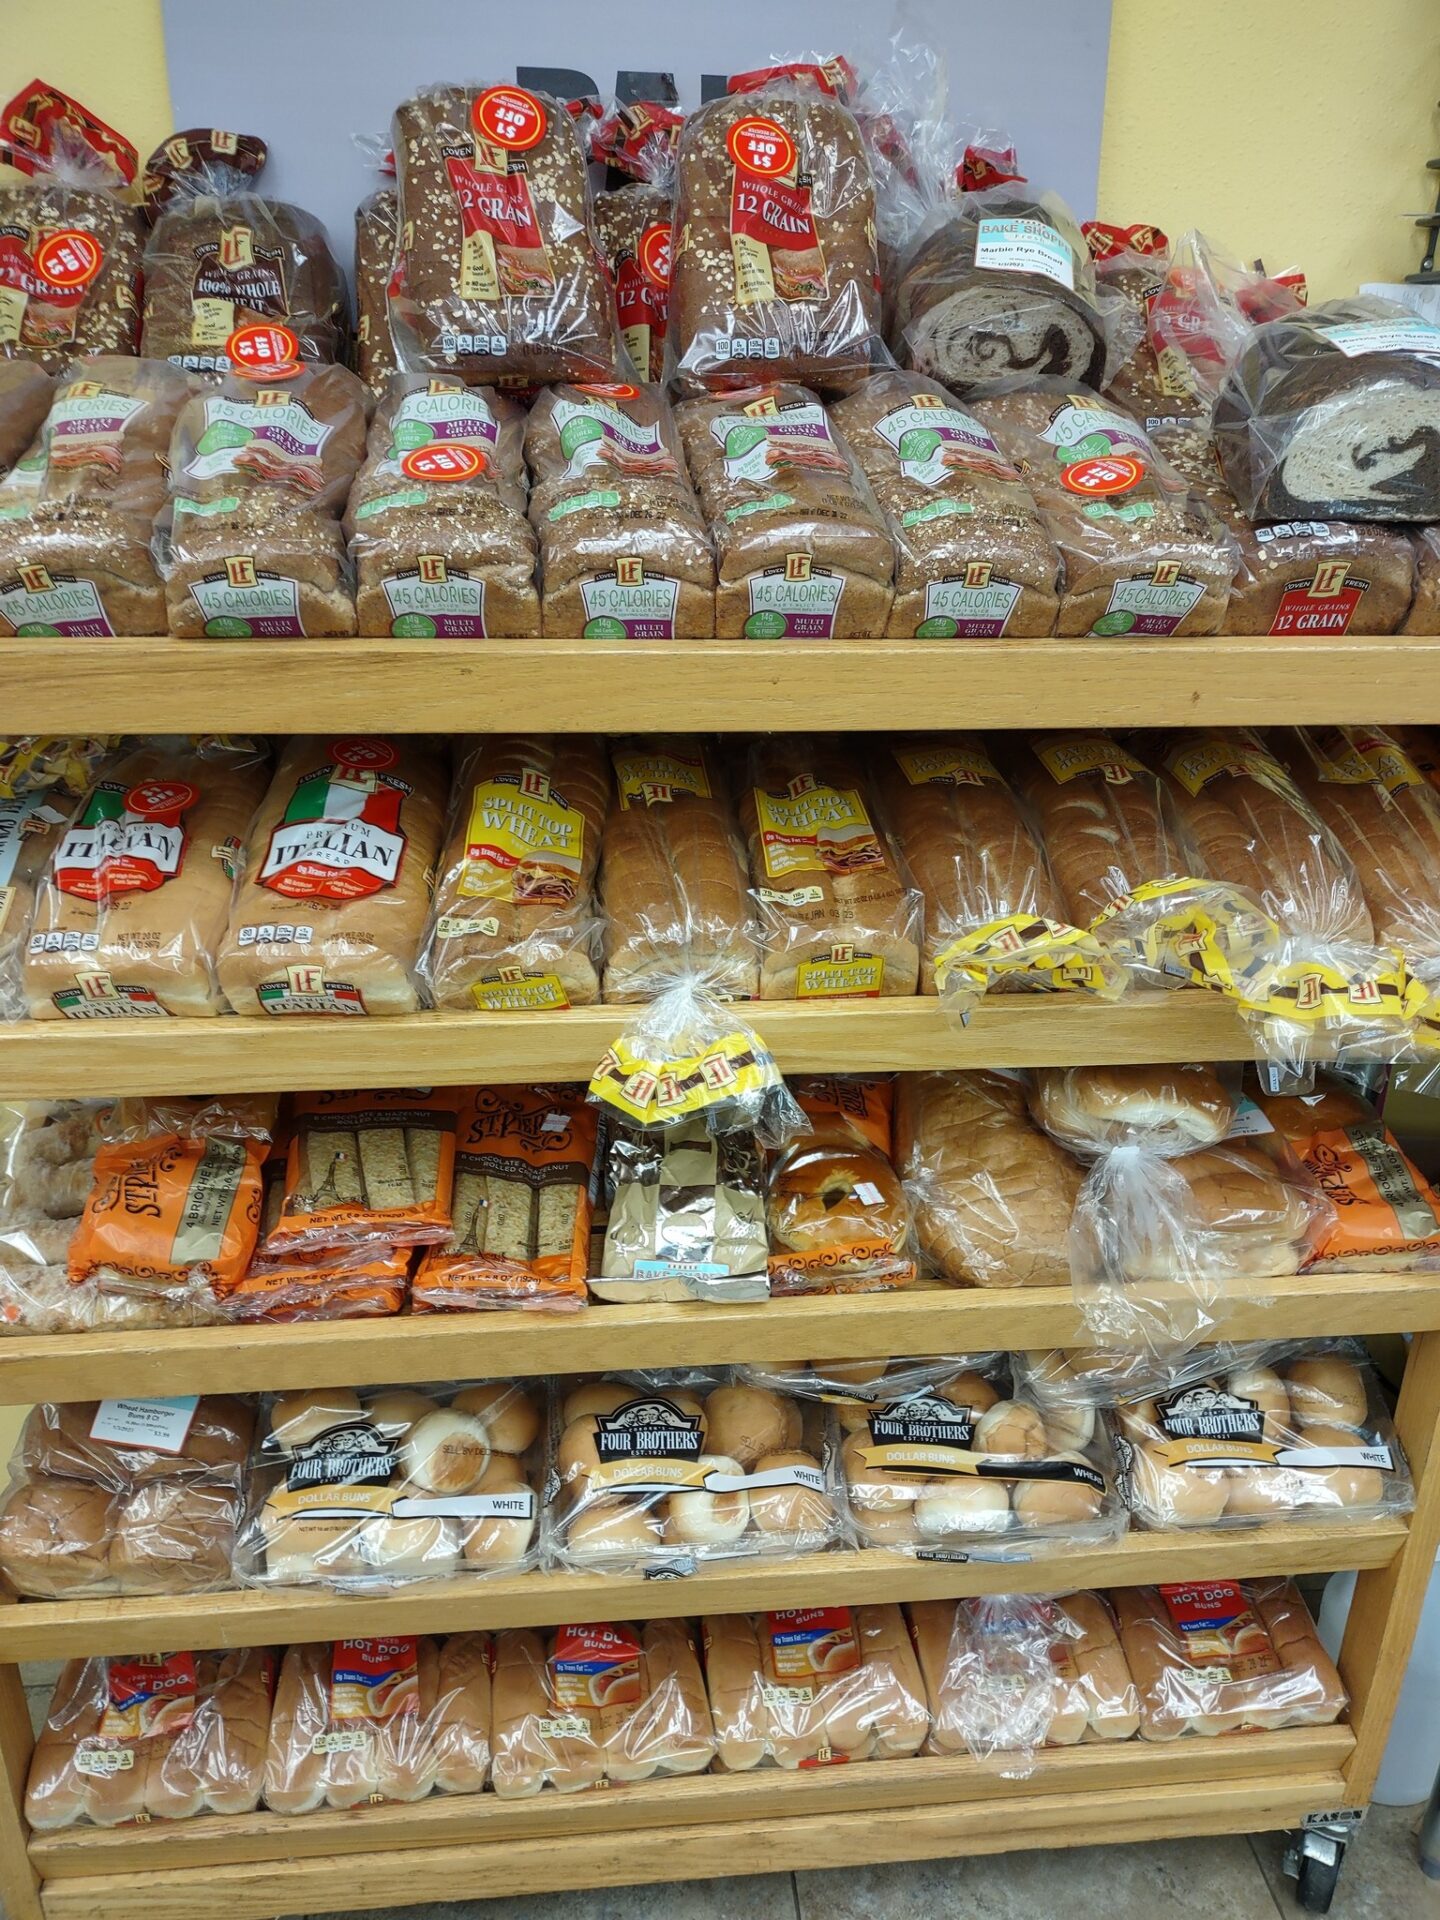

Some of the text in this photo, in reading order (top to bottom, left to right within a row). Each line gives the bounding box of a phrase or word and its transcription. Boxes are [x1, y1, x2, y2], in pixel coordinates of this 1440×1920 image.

[495, 111, 526, 126] OFF
[496, 122, 517, 139] $1
[748, 141, 776, 154] OFF
[754, 155, 771, 167] $1
[742, 181, 778, 198] WHOLE
[457, 190, 474, 208] 12
[737, 193, 810, 233] 12 GRAIN
[981, 224, 1019, 234] BAKE
[198, 278, 281, 298] 100% WHOLE
[619, 290, 636, 307] 12
[239, 341, 254, 356] $1
[254, 335, 271, 358] OFF
[718, 340, 729, 350] 100
[416, 396, 489, 414] CALORIE
[780, 402, 804, 411] FRESH
[240, 407, 319, 438] CALORIES
[582, 402, 652, 440] CALORIES
[887, 416, 907, 435] 45
[1053, 423, 1073, 443] 45
[416, 459, 437, 471] $1
[431, 453, 456, 469] OFF
[1077, 475, 1100, 487] $1
[1087, 467, 1117, 481] OFF
[230, 561, 252, 584] LF
[423, 559, 443, 580] LF
[621, 561, 640, 582] LF
[789, 557, 810, 578] LF
[811, 568, 831, 576] FRESH
[1154, 564, 1179, 584] LF
[968, 566, 990, 586] LF
[1285, 565, 1369, 593] L'OVEN LF FRESH
[204, 588, 292, 609] 45 CALORIES
[394, 586, 477, 604] 45 CALORIES
[590, 589, 671, 608] 45 CALORIES
[755, 585, 836, 602] 45 CALORIES
[932, 591, 1012, 609] 45 CALORIES
[1116, 588, 1195, 608] 45 CALORIES
[6, 588, 95, 616] 45 CALORIES
[1276, 614, 1348, 630] 12 GRAIN
[342, 752, 360, 762] $1
[351, 745, 377, 760] OFF
[379, 774, 412, 793] FRESH
[526, 773, 548, 797] LF
[483, 797, 573, 837] SPLIT TOP
[767, 804, 853, 827] WHEAT
[482, 810, 568, 847] WHEAT
[307, 852, 350, 865] BREAD
[812, 909, 854, 920] JAN 03 23
[834, 947, 852, 962] LF
[806, 967, 877, 979] SPLIT TOP
[84, 976, 113, 999] LF
[294, 970, 320, 993] LF
[805, 975, 876, 990] WHEAT
[482, 983, 554, 999] SPLIT TOP
[271, 1003, 358, 1012] ITALIAN
[485, 992, 558, 1009] WHEAT
[70, 1004, 161, 1019] ITALIAN
[483, 1161, 517, 1172] ROLLED
[188, 1171, 211, 1219] BRIOCHE
[211, 1210, 223, 1226] NET
[118, 1403, 139, 1412] Wheat
[874, 1420, 970, 1440] FOUR BROTHERS
[1164, 1413, 1260, 1435] FOUR BROTHERS
[600, 1432, 698, 1451] FOUR BROTHERS
[1187, 1443, 1253, 1454] DOLLAR BUNS
[886, 1452, 955, 1464] DOLLAR BUNS
[1361, 1452, 1385, 1463] WHITE
[289, 1457, 393, 1480] FOUR BROTHERS
[613, 1466, 683, 1478] DOLLAR BUNS
[793, 1469, 821, 1485] WHITE
[298, 1493, 371, 1504] DOLLAR BUNS
[492, 1500, 524, 1510] WHITE
[1171, 1588, 1235, 1604] HOT DOG
[796, 1610, 825, 1625] BUNS
[566, 1627, 596, 1638] HOT
[782, 1635, 796, 1644] Trans
[343, 1640, 410, 1654] HOT DOG
[564, 1663, 576, 1671] Trans
[153, 1674, 189, 1690] DOG
[1307, 1810, 1362, 1823] KASON
